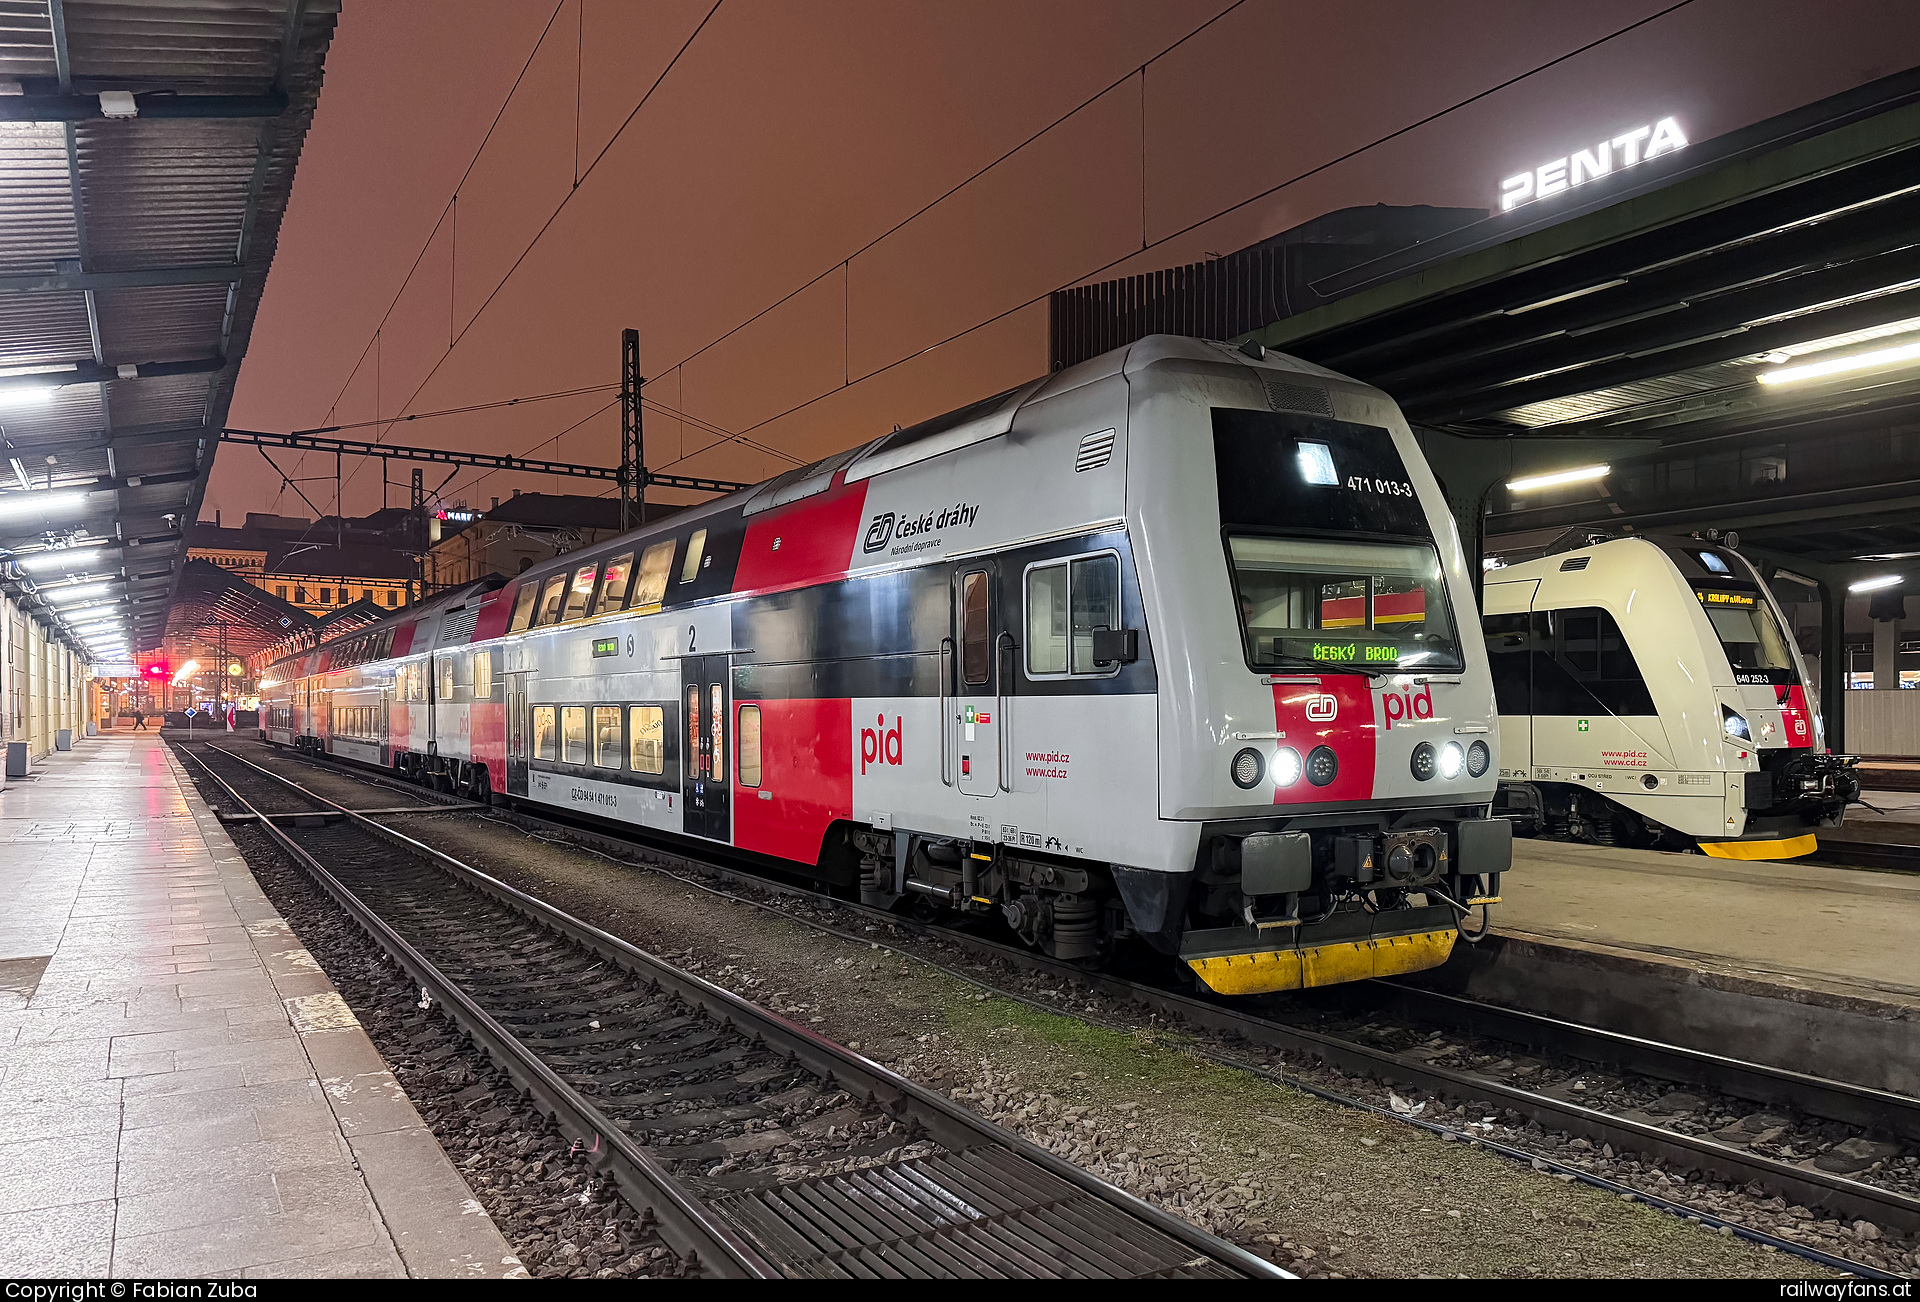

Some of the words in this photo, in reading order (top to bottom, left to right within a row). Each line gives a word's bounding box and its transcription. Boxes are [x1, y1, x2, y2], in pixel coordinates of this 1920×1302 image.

[1502, 116, 1689, 211] PENTA
[1347, 475, 1372, 493] 471
[1375, 478, 1413, 498] 013-3
[895, 510, 934, 539] České
[935, 502, 980, 530] dráhy
[890, 544, 914, 556] Národní
[913, 538, 942, 552] dopravce
[688, 624, 697, 653] 2
[1313, 642, 1356, 661] ČESKÝ
[1365, 646, 1399, 661] BROD
[1736, 674, 1750, 684] 640
[1751, 674, 1769, 684] 252-3
[1382, 683, 1434, 731] pid
[860, 713, 903, 776] pid
[1025, 751, 1070, 764] www.pid.cz
[1601, 750, 1648, 759] www.pid.cz
[1603, 759, 1648, 767] www.cd.cz
[1025, 767, 1068, 779] www.cd.cz
